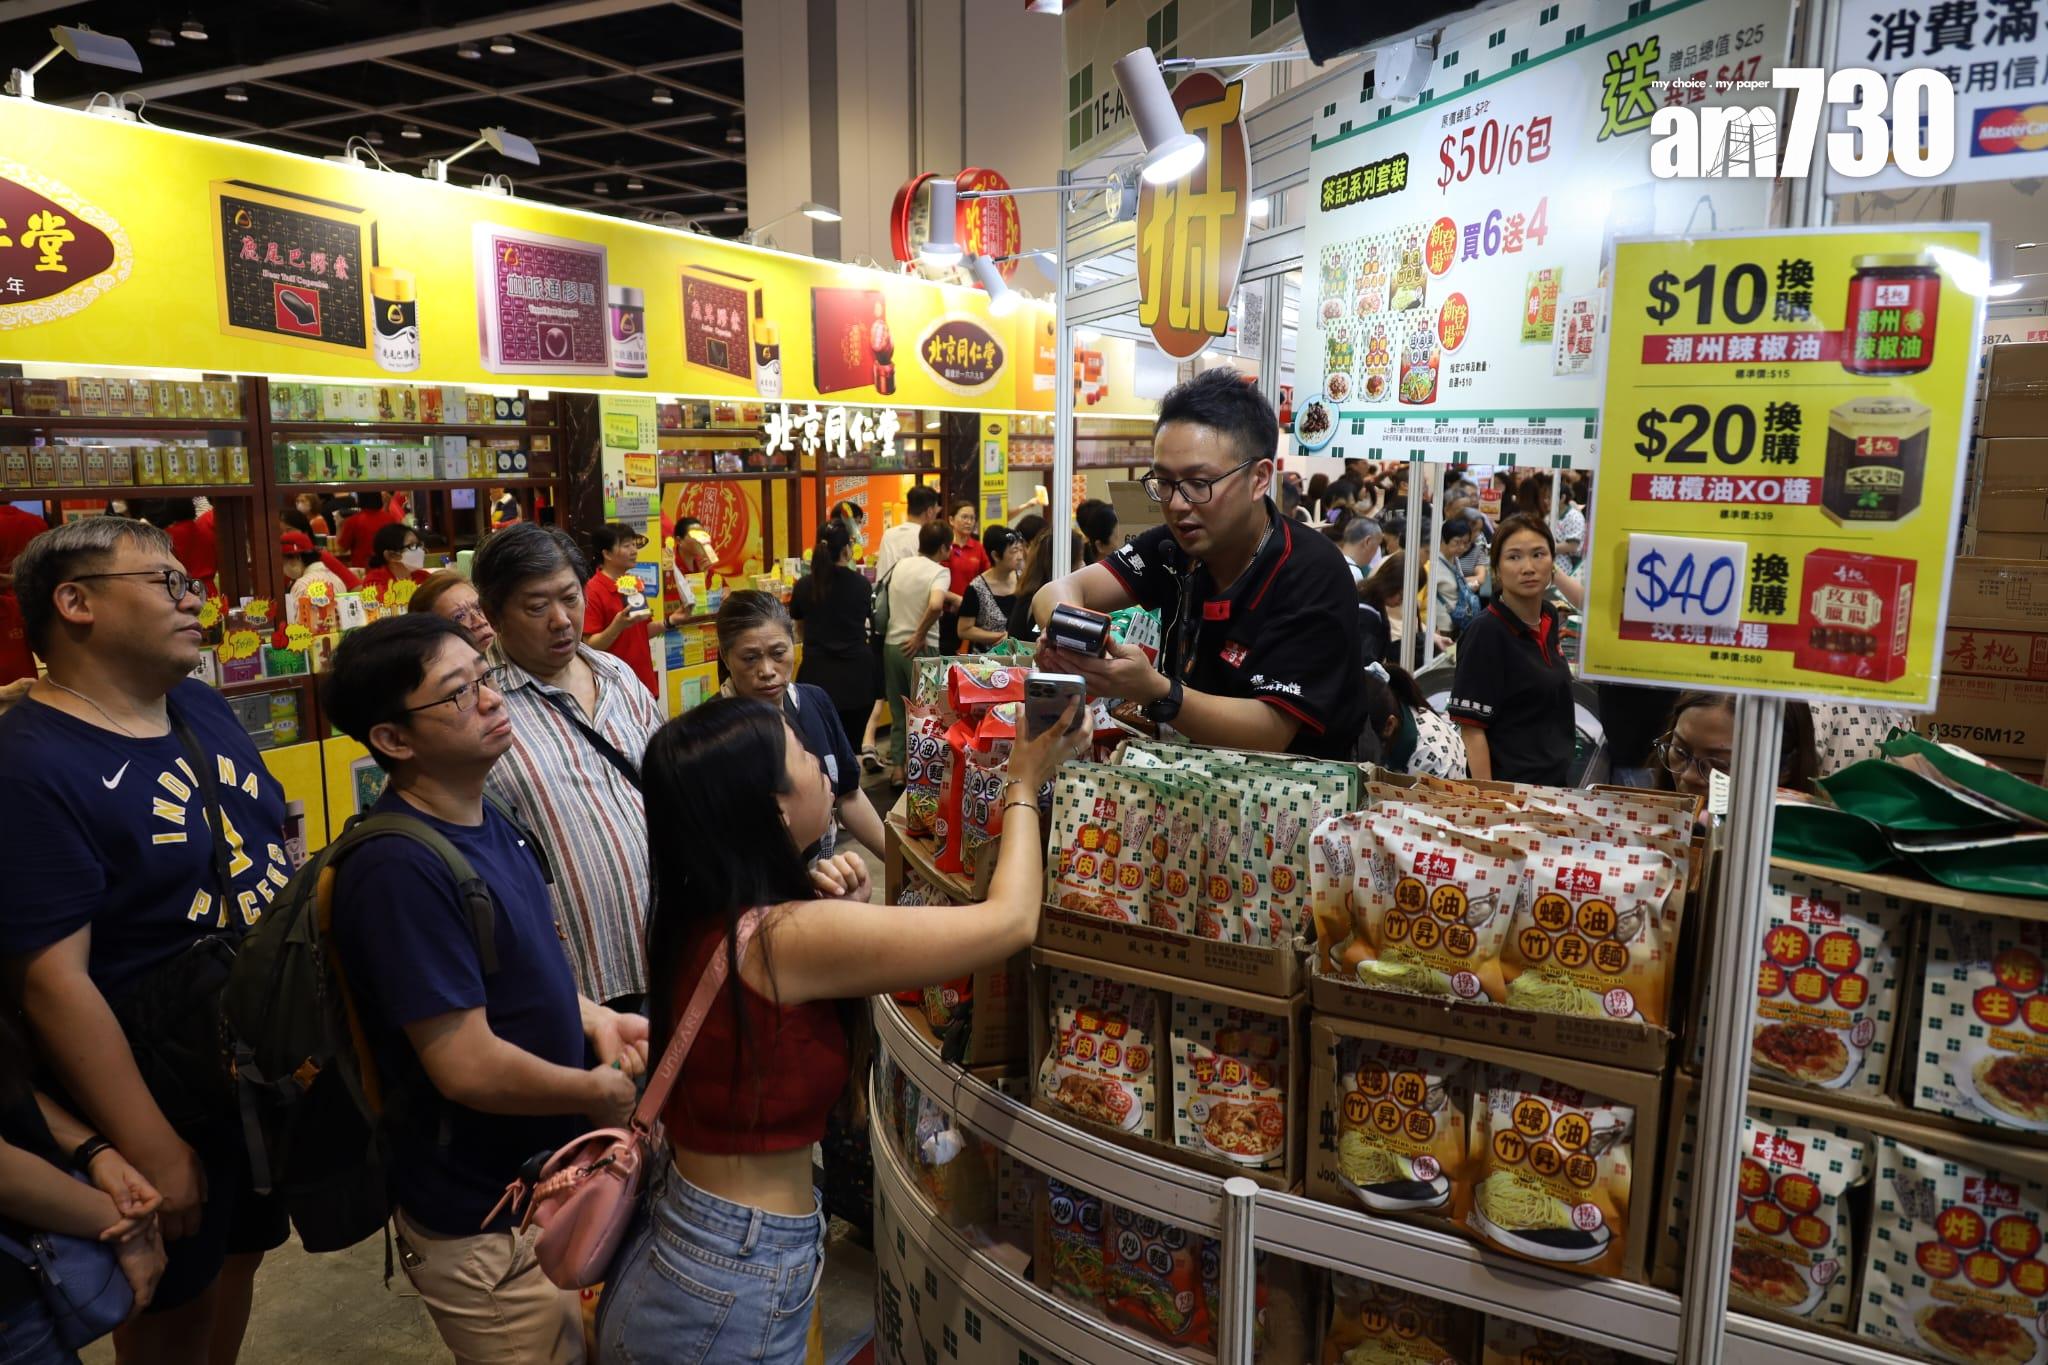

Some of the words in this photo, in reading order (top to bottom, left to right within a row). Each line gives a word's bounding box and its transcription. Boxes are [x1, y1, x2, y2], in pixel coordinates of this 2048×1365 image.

[1668, 34, 1731, 74] 贈品總值
[1735, 24, 1764, 50] $25
[1867, 0, 2048, 61] 消費滿
[1598, 35, 1661, 143] 送
[1716, 55, 1762, 96] $47
[1095, 87, 1131, 134] 1E-A
[1437, 115, 1553, 196] $50/6包
[1322, 157, 1407, 209] 茶記系列套裝
[1430, 222, 1455, 275] 新登場
[1461, 196, 1548, 262] 買6送4
[0, 276, 25, 296] 年
[1646, 263, 1769, 325] $10
[1773, 258, 1816, 323] 換購
[1442, 297, 1466, 350] 新登場
[1576, 314, 1595, 354] 寬麵
[1858, 309, 1901, 334] 潮州
[928, 335, 997, 370] 北京同仁堂
[1665, 333, 1821, 363] 潮州辣椒油
[1855, 335, 1923, 360] 辣椒油
[1735, 368, 1791, 380] 標準價:$15
[765, 404, 901, 458] 北京同仁堂
[1634, 404, 1757, 466] $20
[1761, 401, 1803, 466] 換購
[1649, 477, 1812, 505] 橄欖油XO醬
[1720, 509, 1774, 522] 標準價:$39
[1635, 549, 1735, 616] $40
[1747, 553, 1790, 616] 換購
[1928, 722, 2026, 745] 93576M12
[152, 754, 260, 846] INDINA
[1399, 882, 1461, 915] 蠔油
[1539, 898, 1610, 933] 蠔油
[1386, 913, 1471, 951] 竹昇麵
[1525, 932, 1623, 968] 竹昇麵
[1771, 930, 1853, 967] 炸醬
[1613, 1006, 1629, 1016] MIX
[1349, 1096, 1431, 1136] 竹昇麵
[1518, 1103, 1584, 1145] 蠔油
[1501, 1134, 1593, 1182] 竹昇麵
[1944, 1213, 2031, 1253] 炸醬
[1927, 1247, 2046, 1294] 生麵皇
